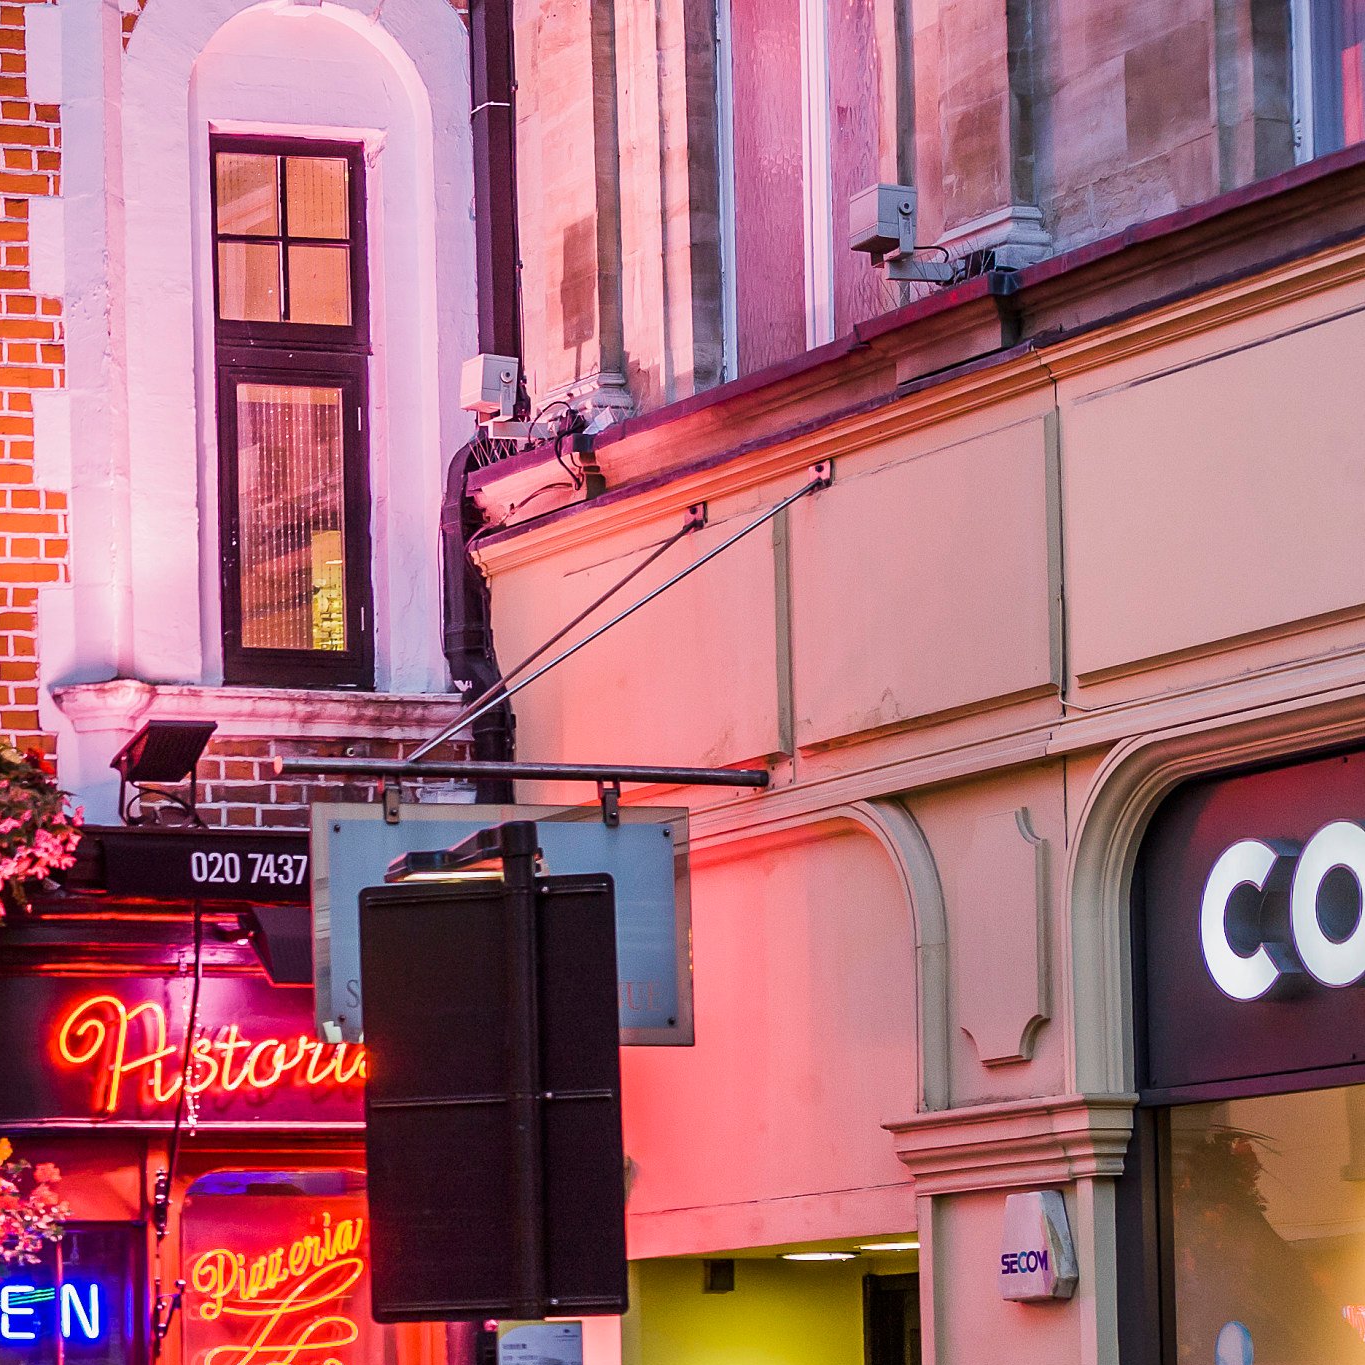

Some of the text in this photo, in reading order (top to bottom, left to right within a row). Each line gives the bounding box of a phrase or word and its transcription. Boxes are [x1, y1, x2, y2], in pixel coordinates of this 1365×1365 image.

[190, 851, 308, 885] 020 7437
[191, 1210, 364, 1320] Pizzeria
[1000, 1251, 1049, 1274] SECOM
